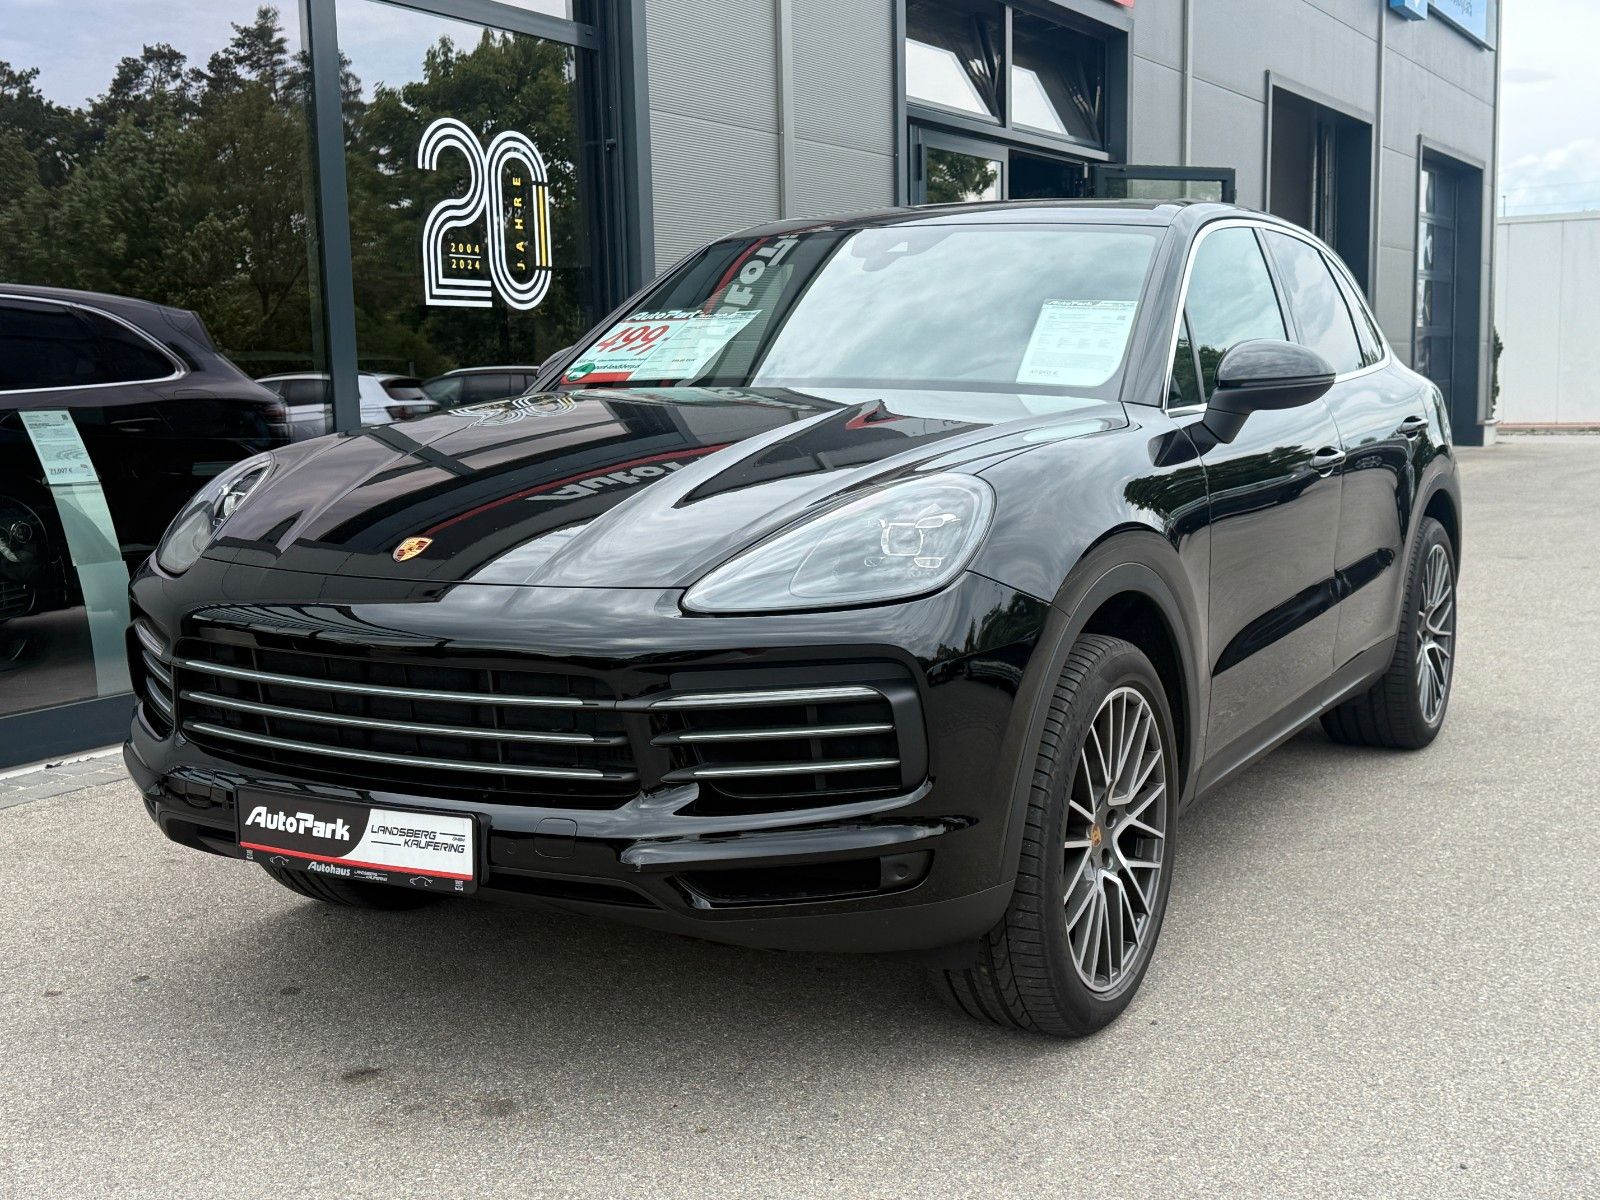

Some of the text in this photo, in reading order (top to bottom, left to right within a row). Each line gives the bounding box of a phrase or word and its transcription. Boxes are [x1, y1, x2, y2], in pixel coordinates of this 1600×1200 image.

[418, 117, 552, 310] 20
[513, 177, 526, 270] JAHRE
[450, 242, 480, 254] 2004
[451, 258, 480, 270] 2024
[245, 806, 350, 841] AutoPark
[370, 825, 437, 840] LANDSBERG
[404, 839, 466, 853] KAUFERING
[307, 861, 351, 877] Autohaus
